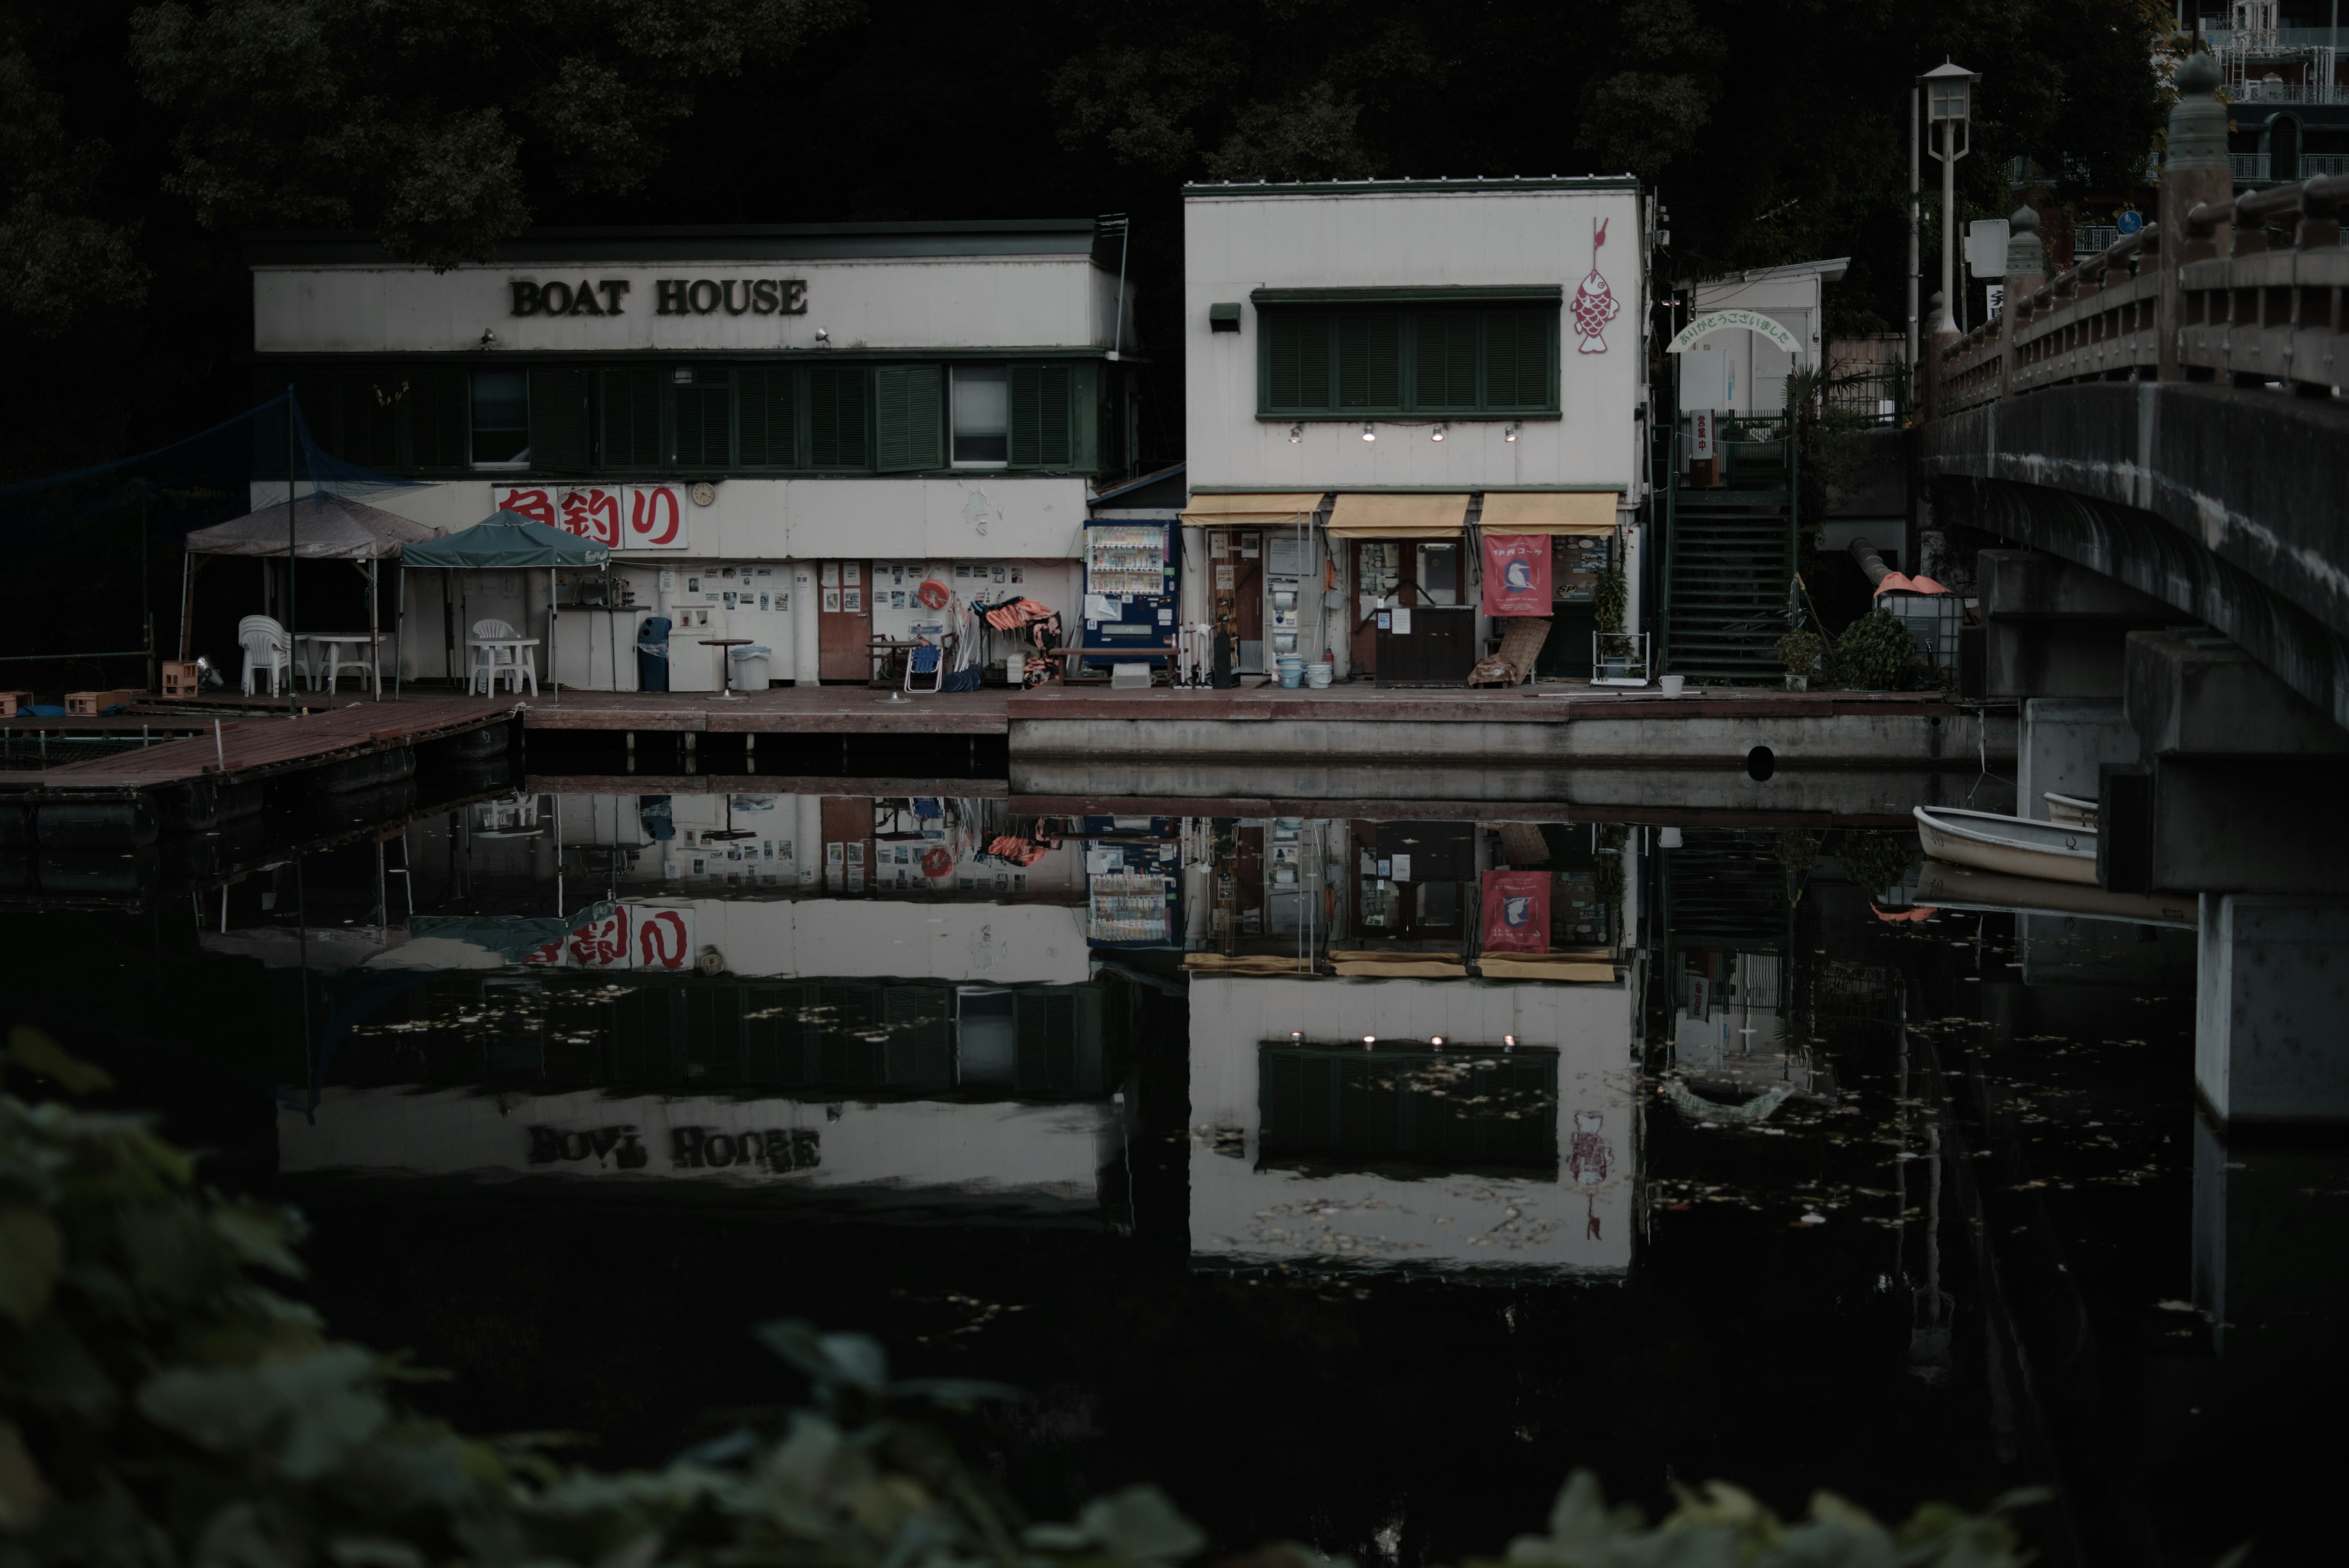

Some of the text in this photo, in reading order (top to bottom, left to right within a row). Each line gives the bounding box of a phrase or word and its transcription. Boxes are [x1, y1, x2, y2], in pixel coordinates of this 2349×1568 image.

[509, 279, 808, 315] BOAT HOUSE
[1679, 313, 1790, 345] ありがとうございました
[1697, 415, 1706, 451] 営業中
[1493, 548, 1542, 556] 伊良コーラ
